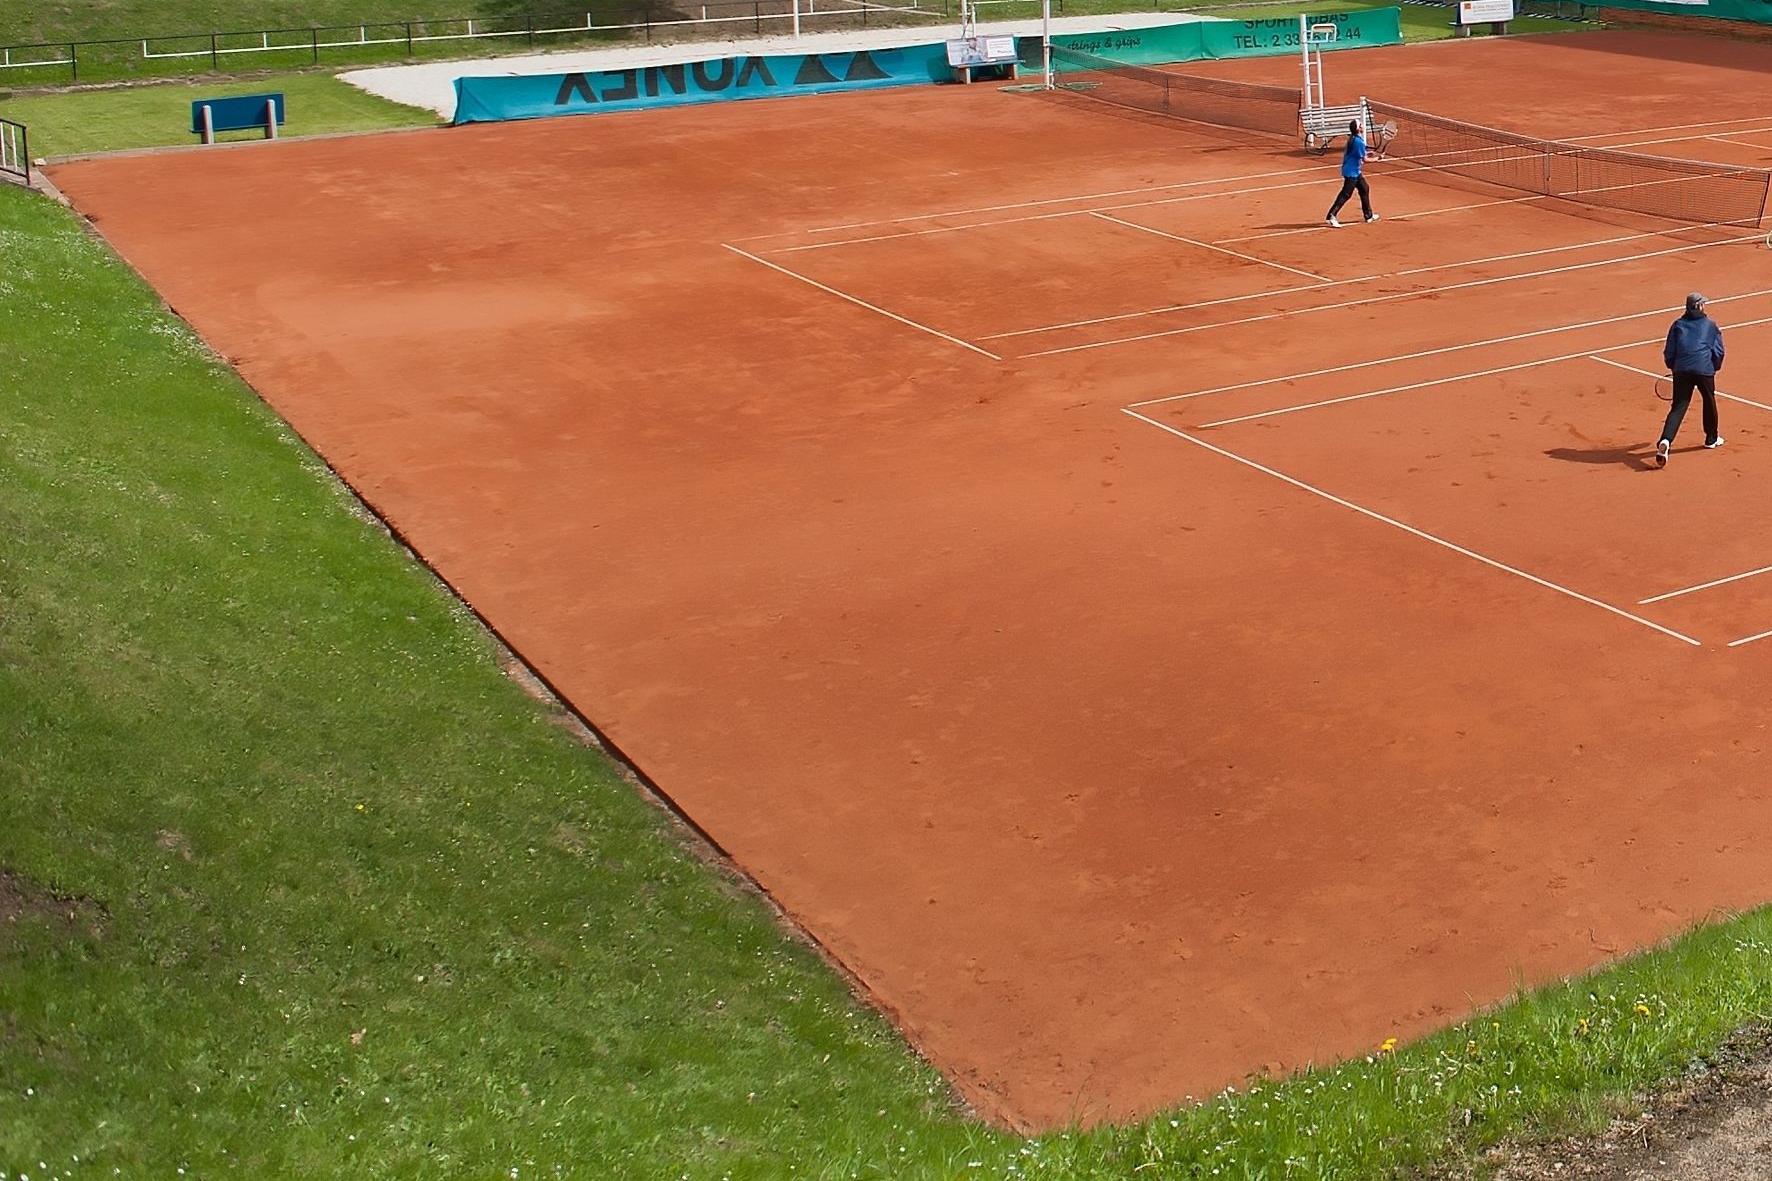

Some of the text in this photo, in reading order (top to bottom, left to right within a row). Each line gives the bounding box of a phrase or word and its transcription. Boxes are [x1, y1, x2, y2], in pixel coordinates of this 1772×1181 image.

[1115, 35, 1142, 50] grips
[1234, 35, 1268, 49] TEL:
[1272, 34, 1281, 46] 2
[1284, 33, 1300, 46] 33
[1346, 27, 1360, 39] 44
